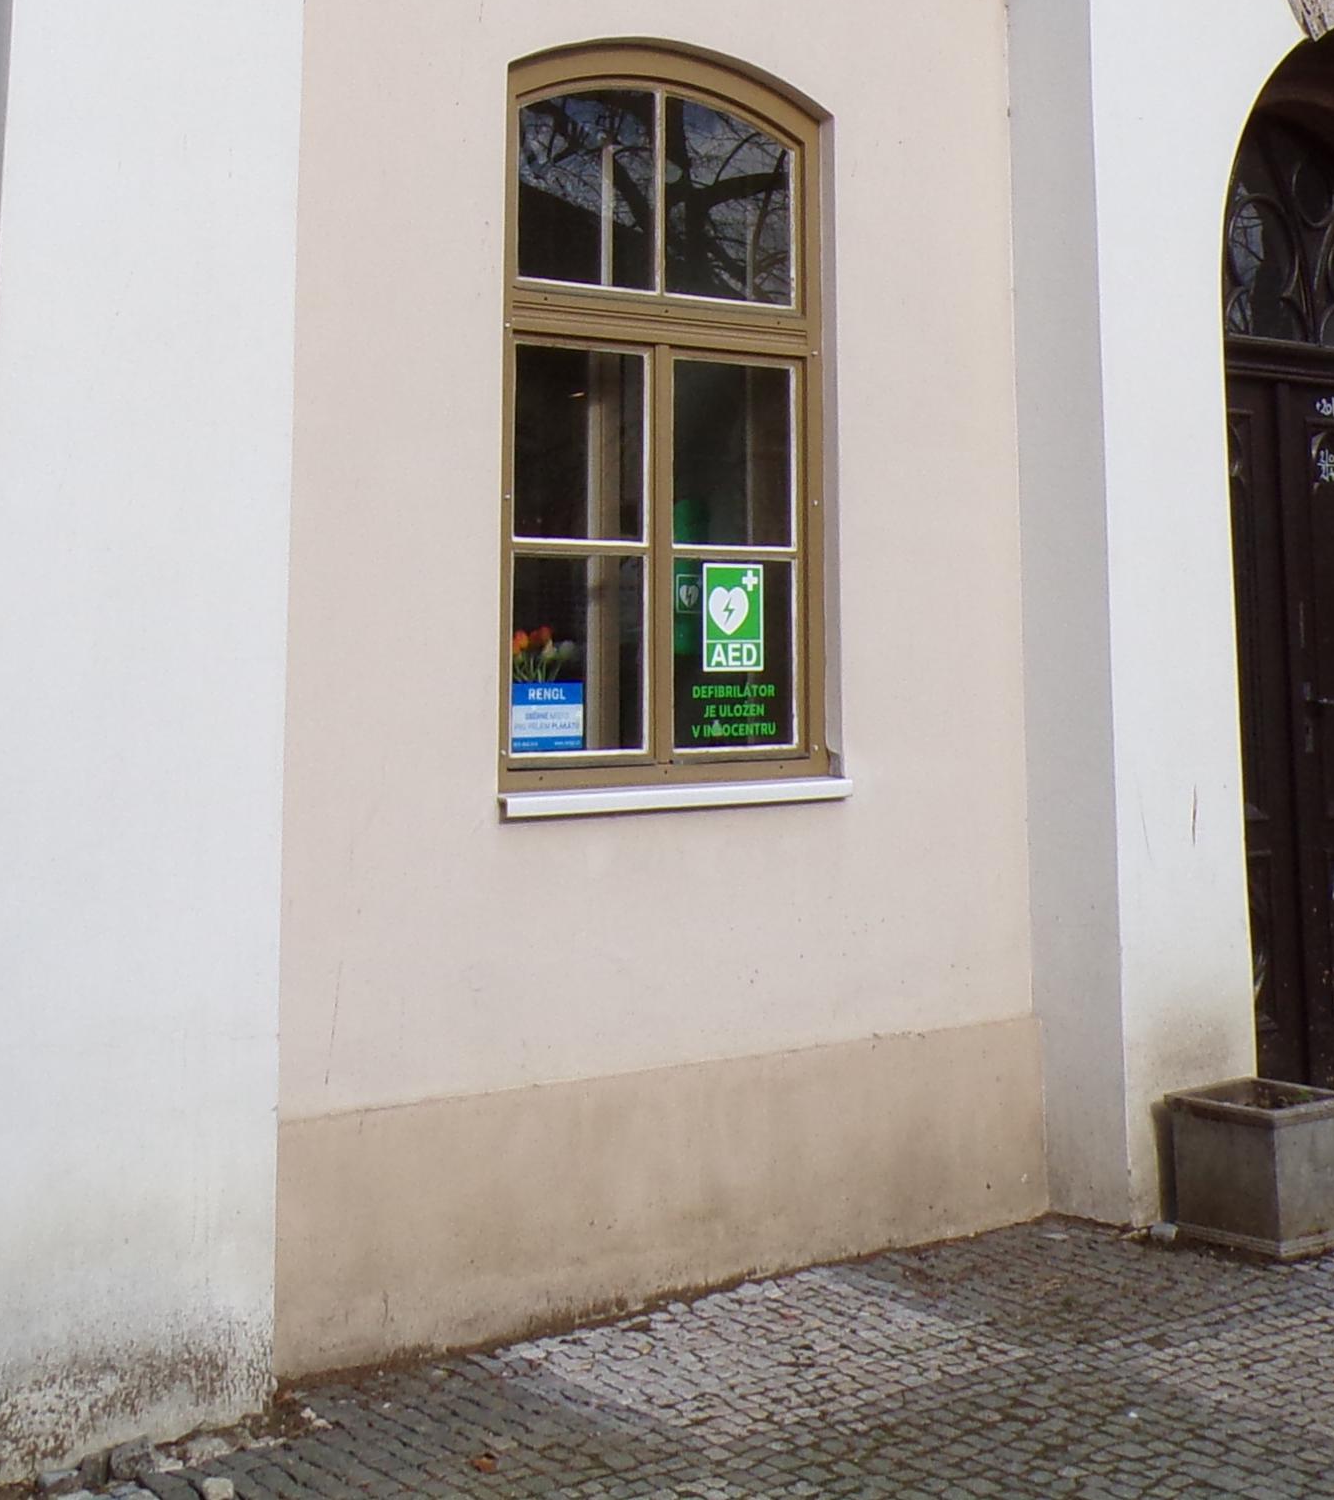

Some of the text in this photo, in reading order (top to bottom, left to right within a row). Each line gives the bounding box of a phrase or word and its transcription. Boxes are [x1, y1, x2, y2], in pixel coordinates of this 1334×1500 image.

[710, 642, 758, 668] AED
[528, 687, 567, 701] RENGL
[692, 682, 776, 699] DEFIBRILÁTOR
[703, 700, 765, 718] JE ULOŽEN
[691, 721, 776, 739] V INOCENTRU
